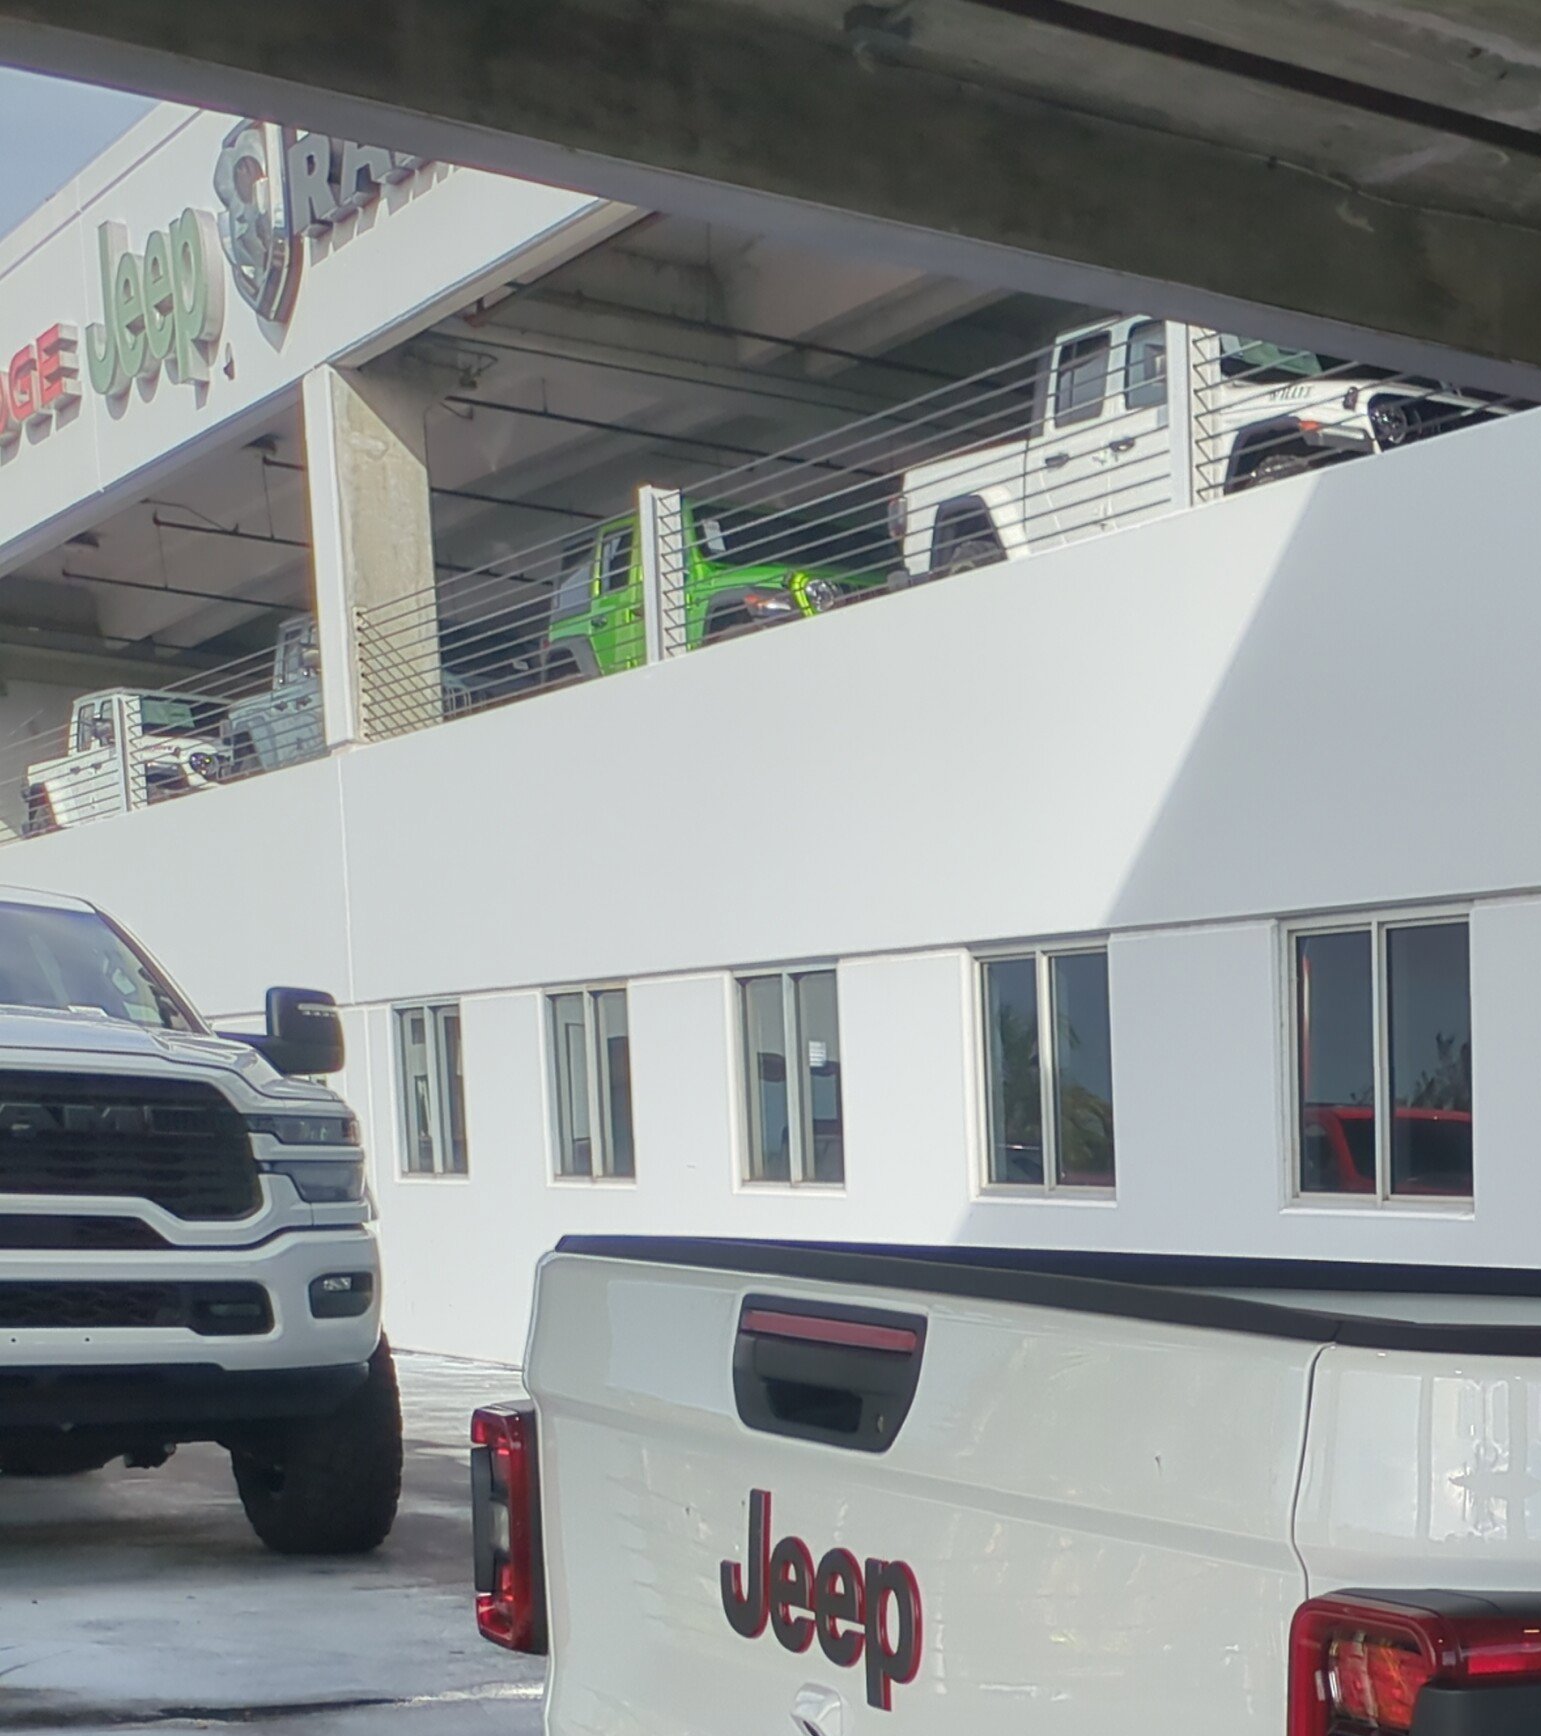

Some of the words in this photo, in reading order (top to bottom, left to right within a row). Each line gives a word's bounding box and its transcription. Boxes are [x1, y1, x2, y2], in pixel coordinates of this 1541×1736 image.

[0, 322, 80, 434] GE
[85, 207, 222, 394] Jeep
[720, 1488, 923, 1712] Jeep
